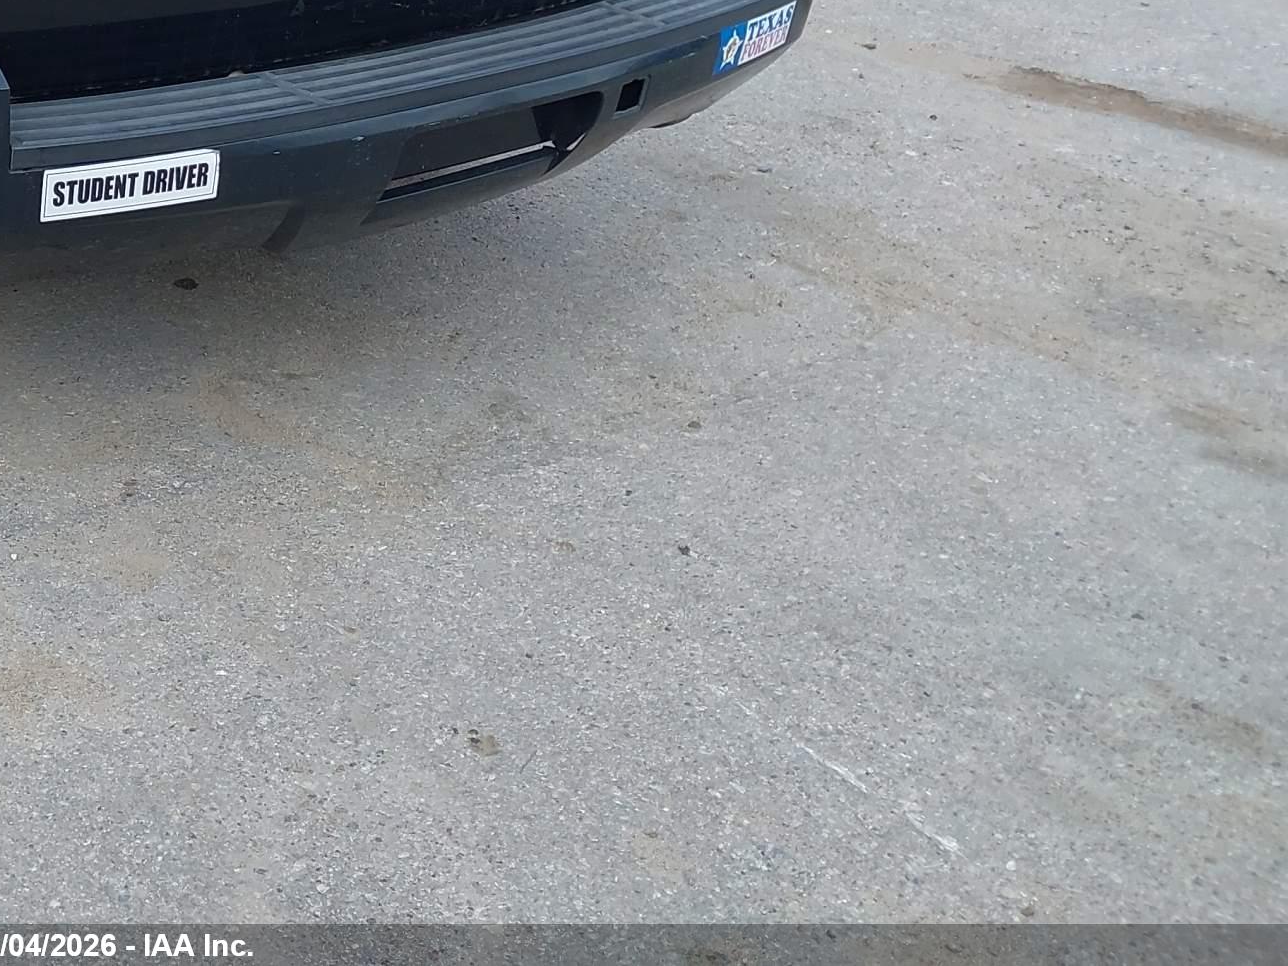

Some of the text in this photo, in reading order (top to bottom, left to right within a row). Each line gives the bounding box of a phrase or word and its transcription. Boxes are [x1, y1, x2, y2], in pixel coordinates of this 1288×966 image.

[747, 4, 794, 41] TEXAS
[52, 162, 209, 208] STUDENT DRIVER
